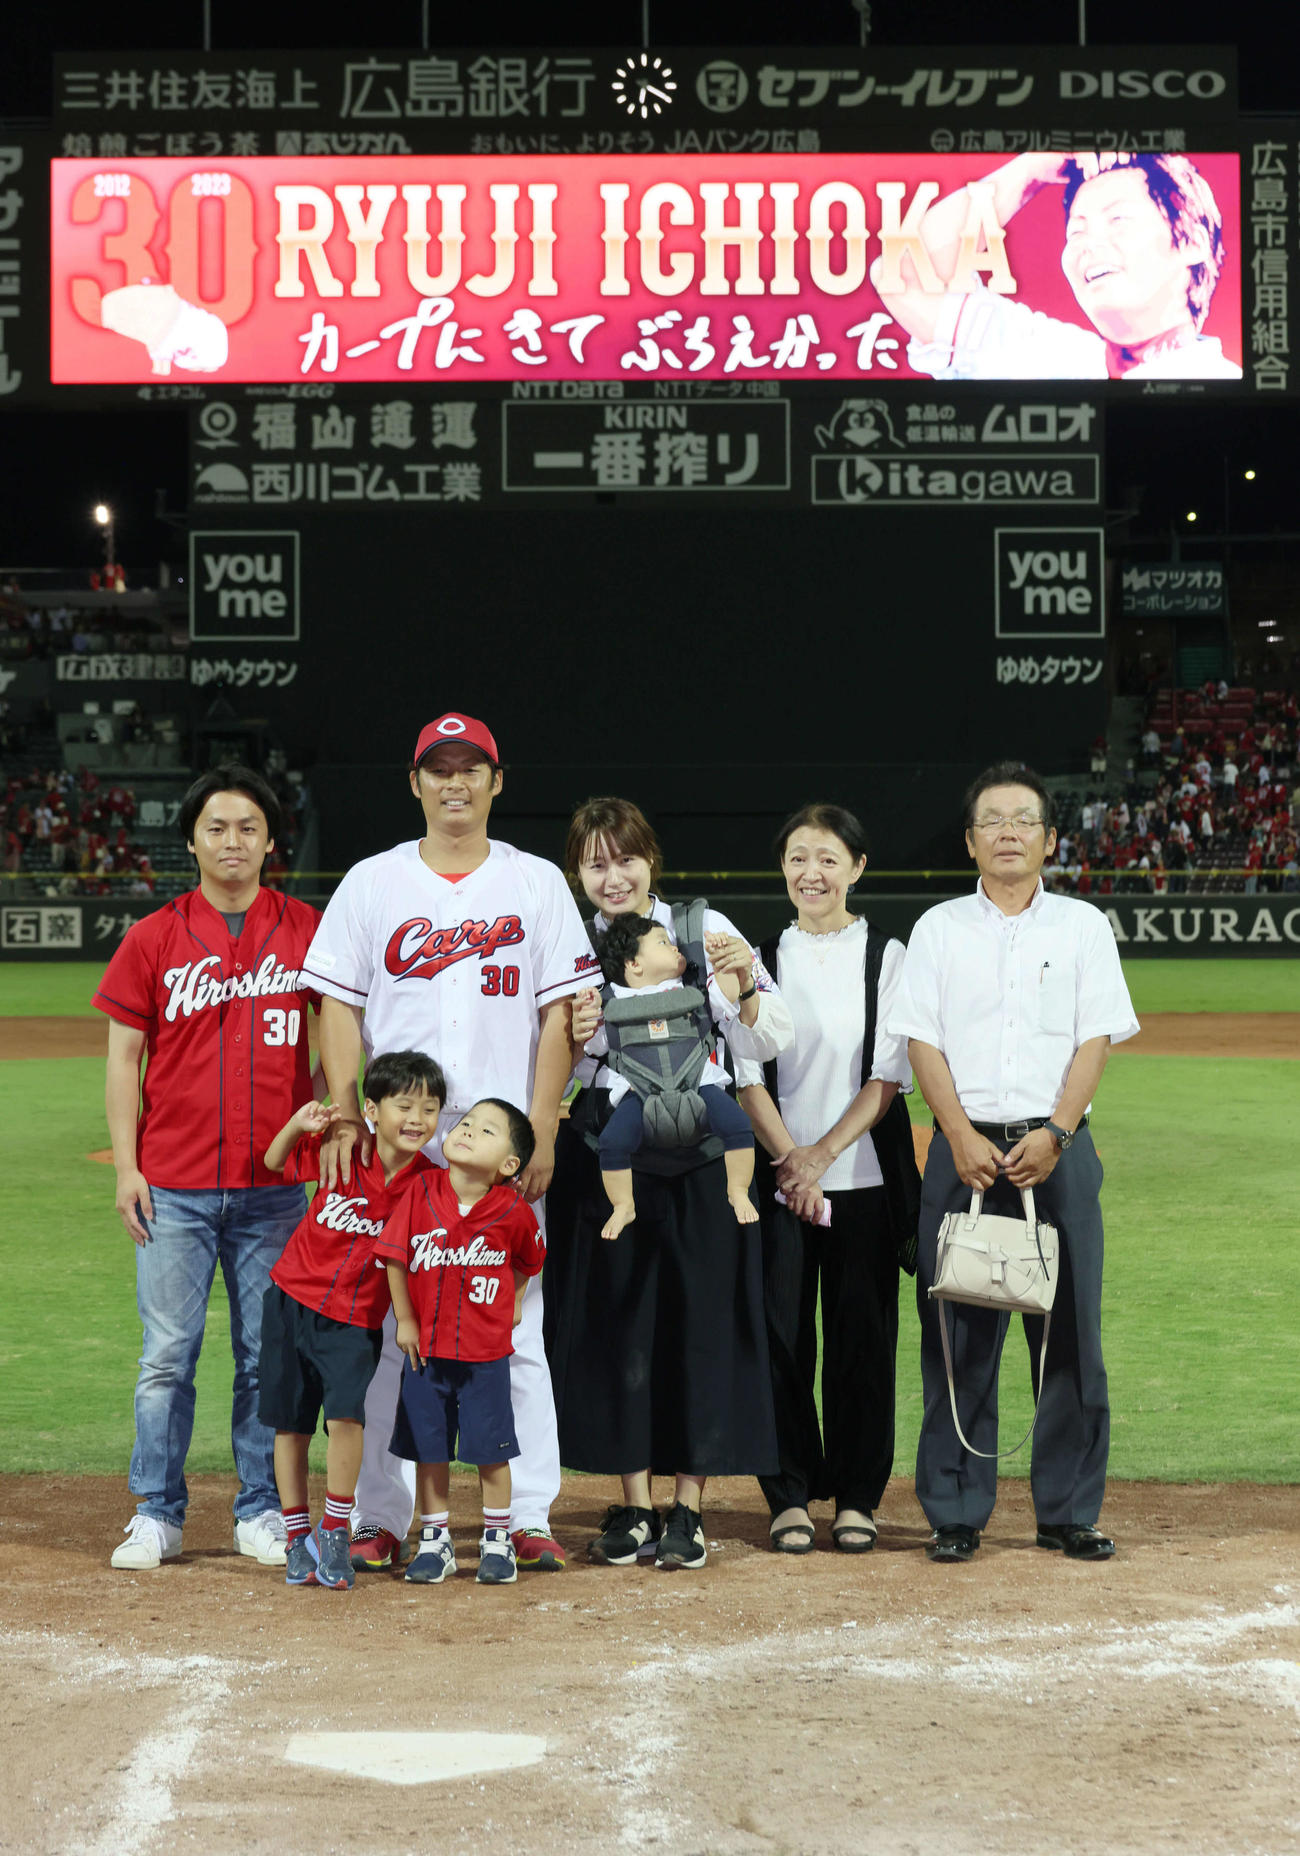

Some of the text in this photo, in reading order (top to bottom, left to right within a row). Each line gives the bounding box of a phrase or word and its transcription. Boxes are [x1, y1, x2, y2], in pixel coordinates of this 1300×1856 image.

[62, 70, 319, 110] 三井住友海上
[340, 56, 596, 119] 広島銀行
[1059, 70, 1226, 98] DISCO
[665, 129, 821, 153] JAバンク広島
[960, 129, 1186, 152] 広島アルミニウム工業
[93, 174, 131, 197] 2012
[191, 173, 232, 196] 2023
[274, 181, 1018, 298] RYUJI ICHIOKA
[1250, 141, 1290, 391] 広島市信用組合
[604, 405, 688, 429] KIRIN
[981, 403, 1096, 442] ムロオ
[533, 432, 759, 486] 一番搾り
[252, 463, 481, 502] 西川ゴム工業
[203, 554, 282, 591] you
[1008, 551, 1087, 588] you
[1151, 570, 1223, 589] マツオカ
[219, 588, 287, 618] me
[1024, 585, 1092, 614] me
[1122, 593, 1222, 611] コーポレーション
[190, 659, 297, 687] ゆめタウン
[996, 656, 1103, 685] ゆめタウン
[384, 914, 526, 983] Carp
[480, 965, 520, 997] 30
[262, 1008, 301, 1046] 30
[468, 1275, 500, 1305] 30
